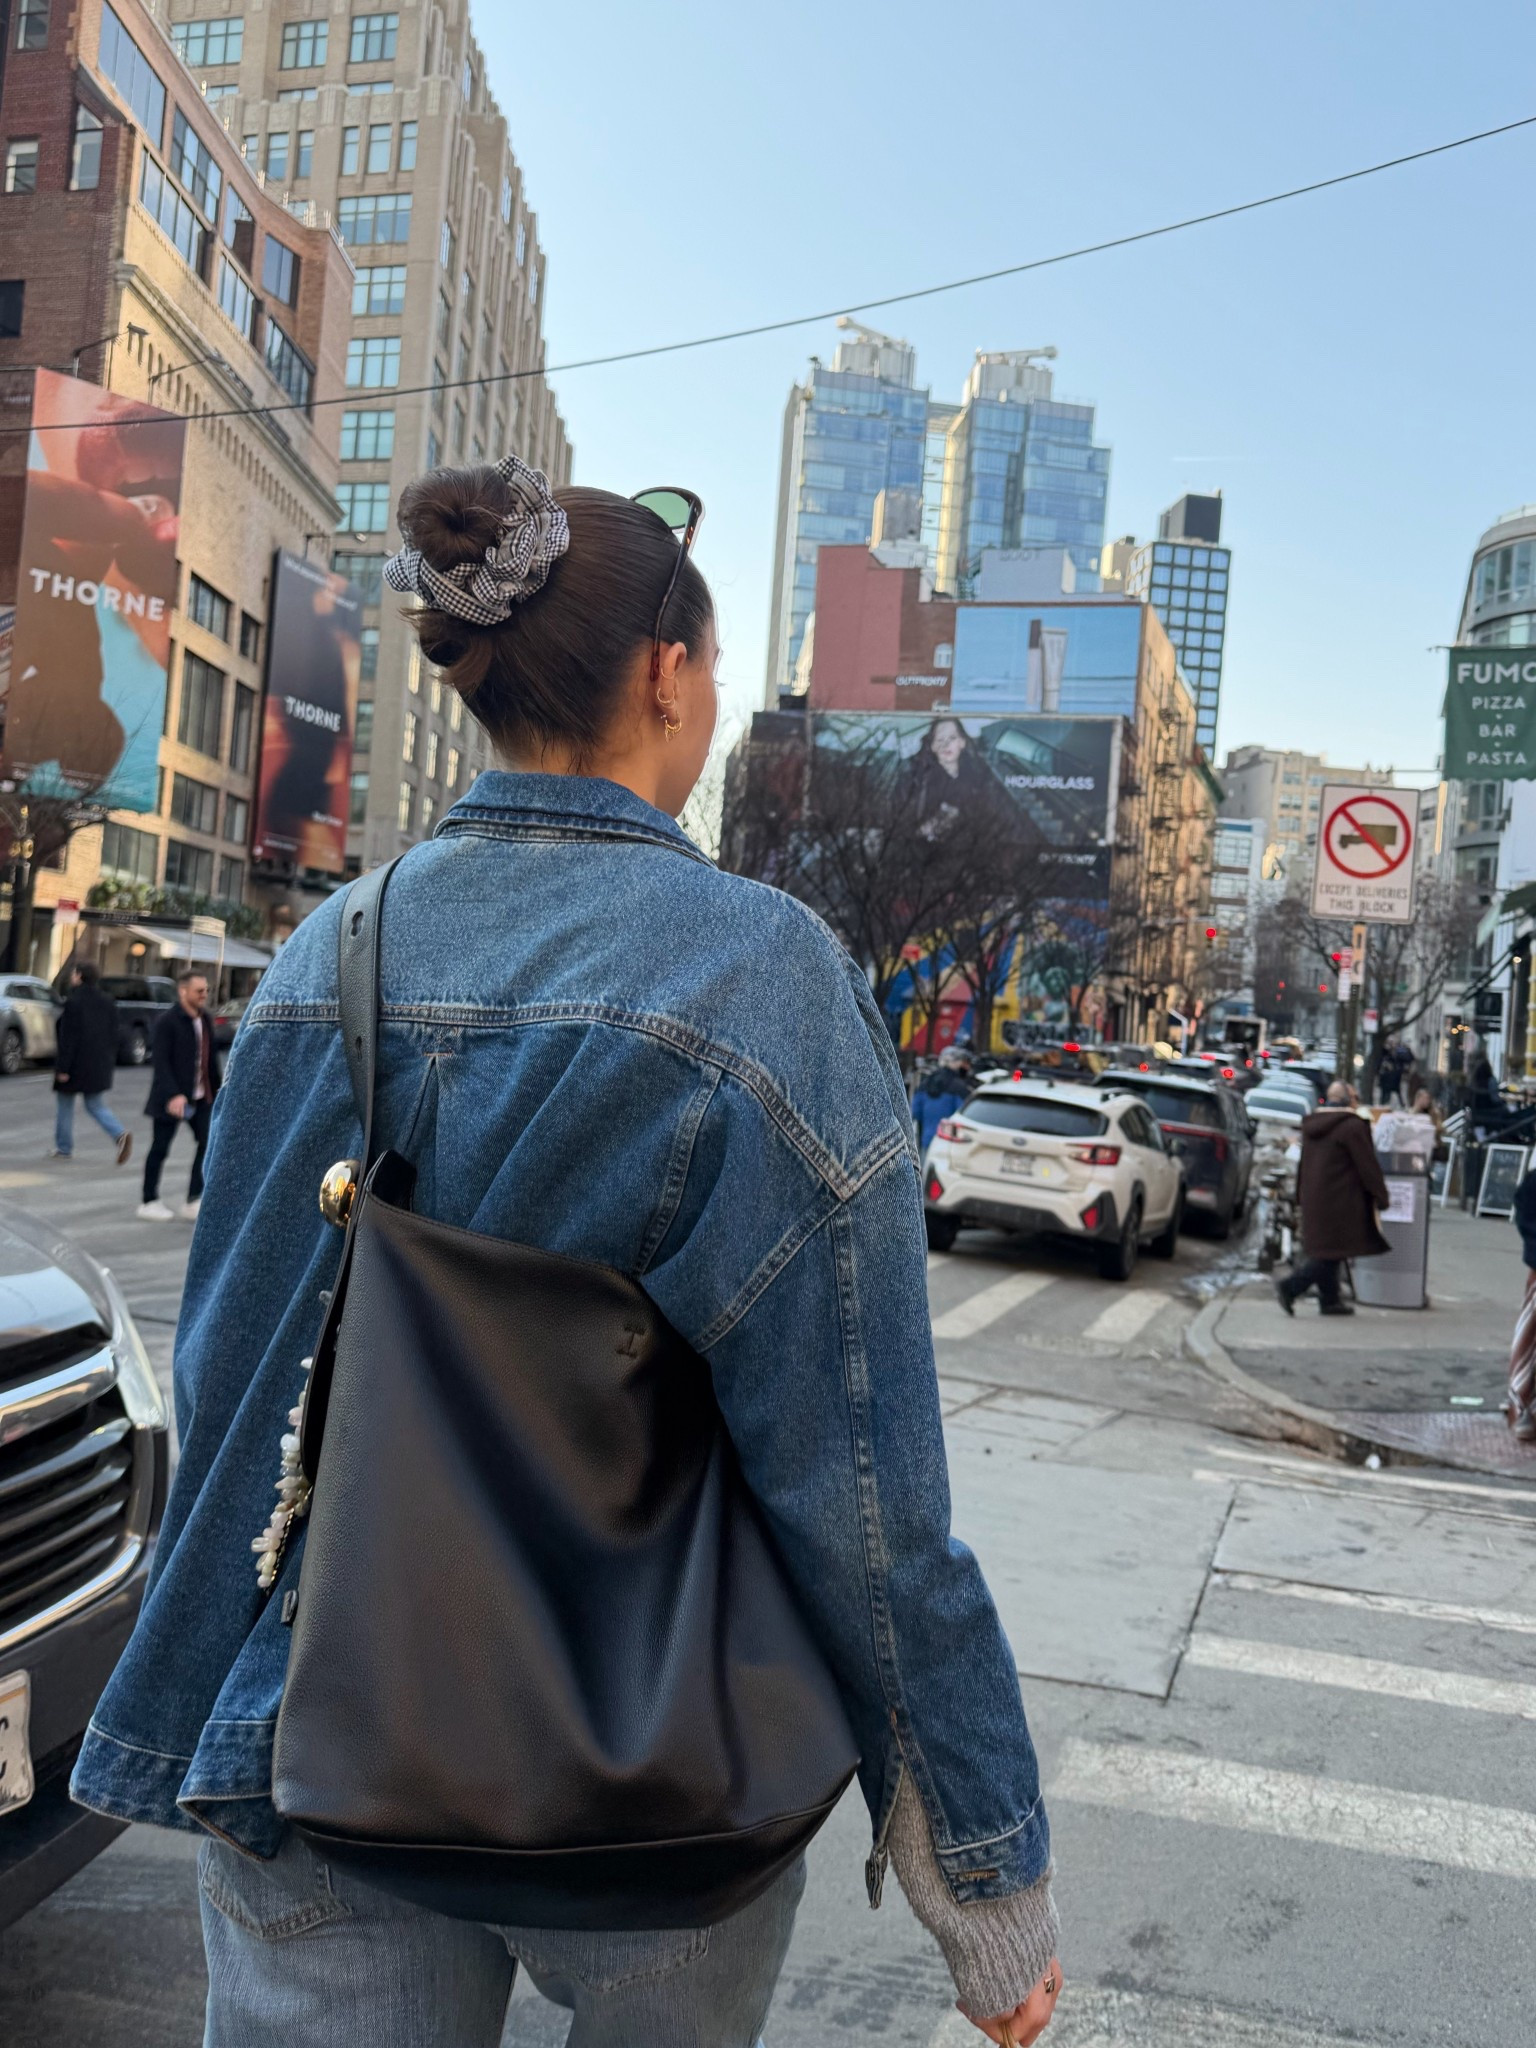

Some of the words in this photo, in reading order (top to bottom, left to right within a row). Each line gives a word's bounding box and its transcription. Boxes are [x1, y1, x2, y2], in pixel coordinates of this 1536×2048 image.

[29, 567, 165, 622] THORNE
[1471, 696, 1527, 710] PIZZA
[285, 695, 342, 732] THORNE
[1478, 723, 1517, 738] BAR
[1466, 751, 1527, 766] PASTA
[1004, 775, 1095, 790] HOURGLASS
[1319, 884, 1352, 896] EXCEPT
[1356, 886, 1408, 900] DELIVERIES
[1329, 899, 1354, 911] THIS
[1360, 901, 1395, 913] BLOCK
